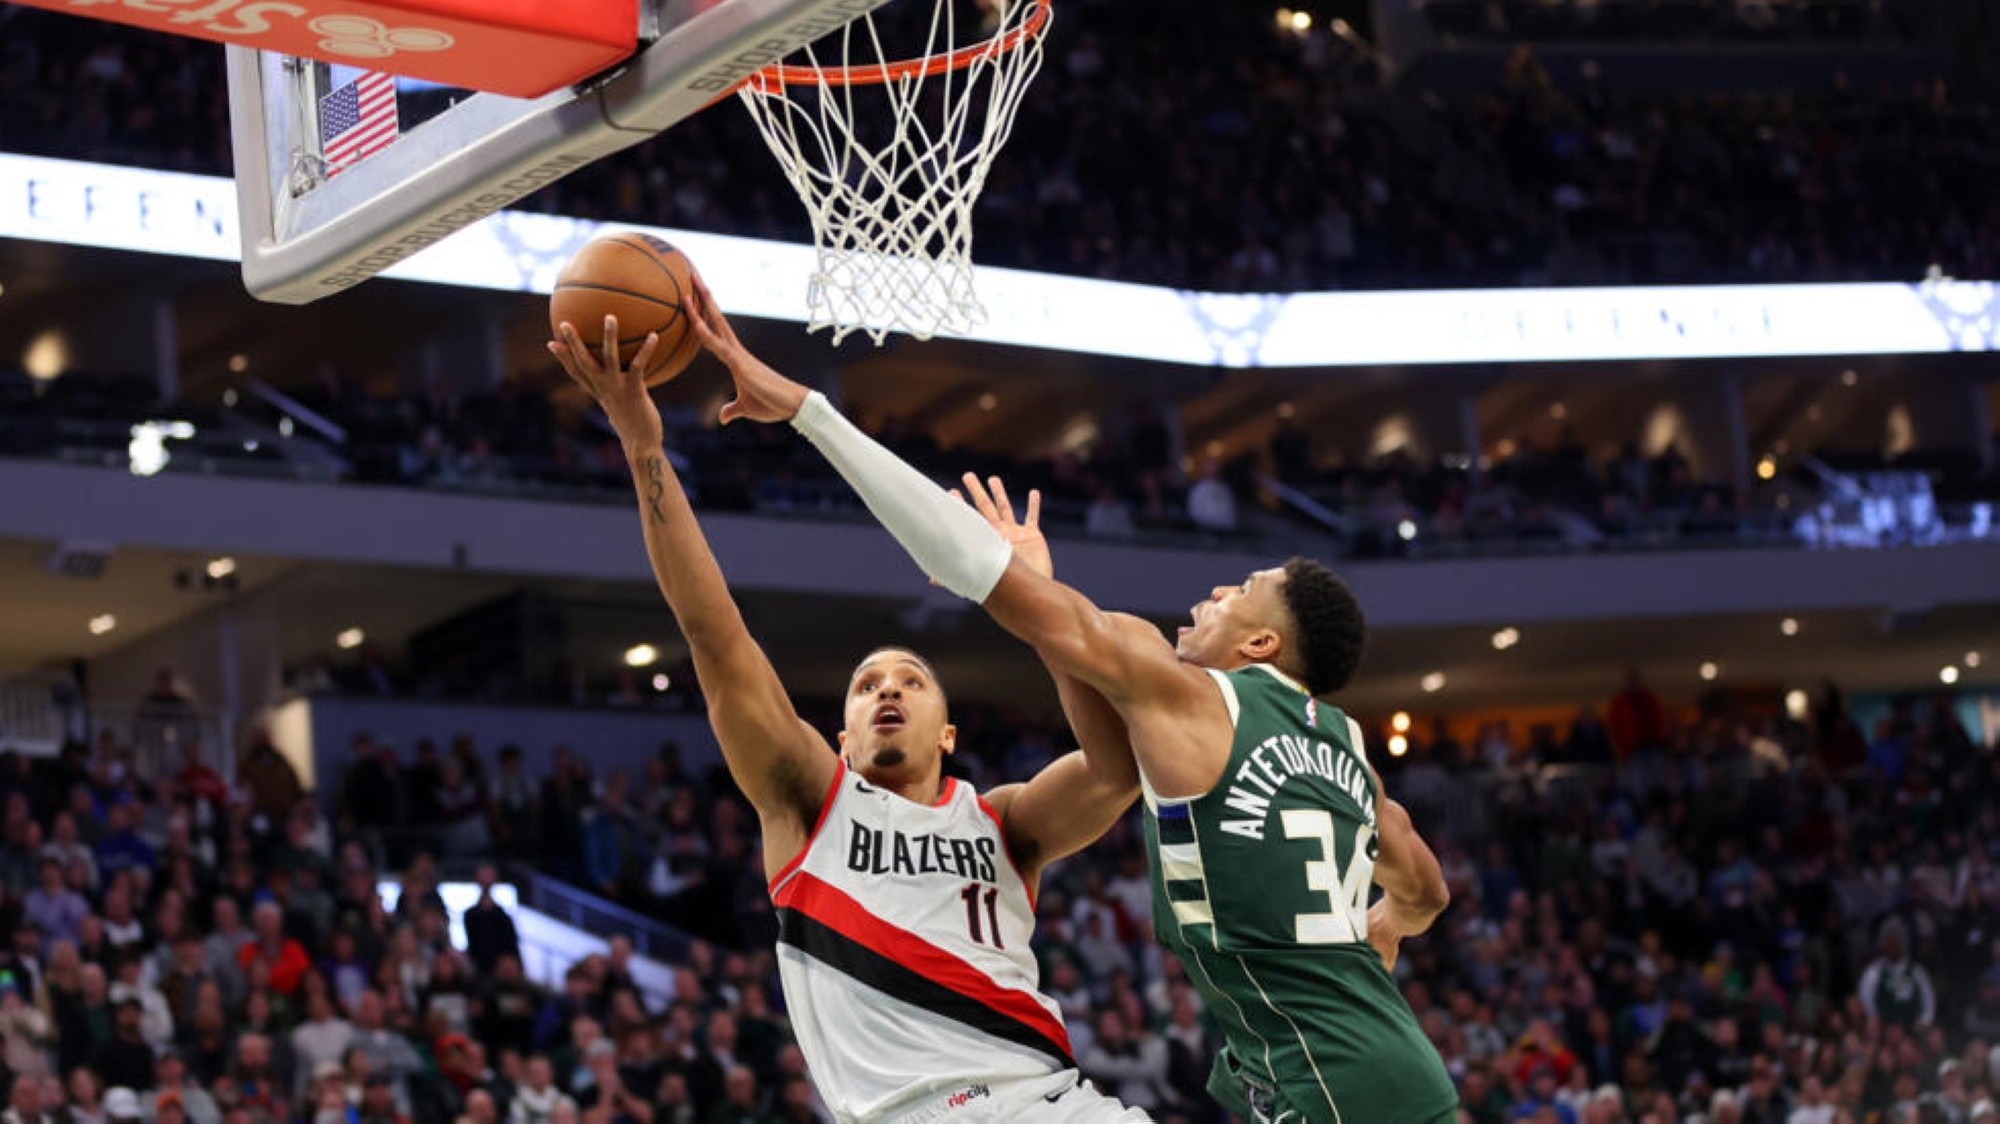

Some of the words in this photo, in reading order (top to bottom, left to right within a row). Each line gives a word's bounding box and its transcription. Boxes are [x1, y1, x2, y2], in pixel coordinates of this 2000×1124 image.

[848, 818, 996, 883] BLAZERS
[1280, 809, 1376, 944] 34
[961, 882, 1005, 951] 11
